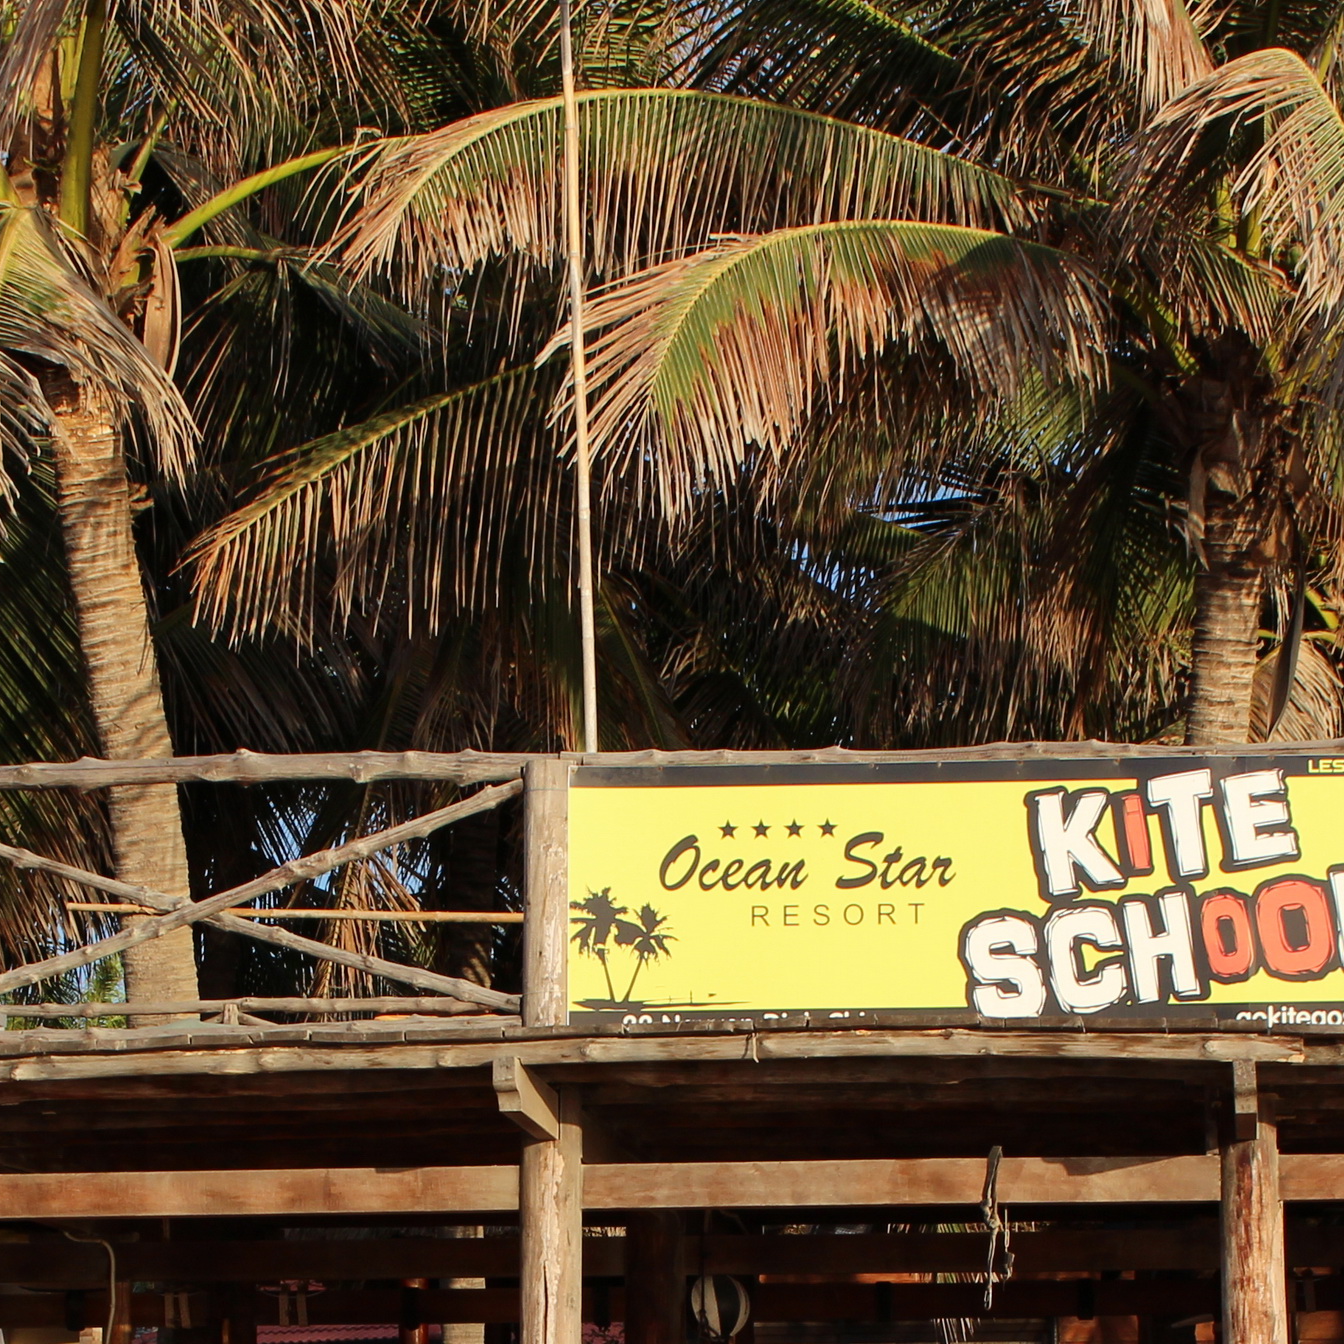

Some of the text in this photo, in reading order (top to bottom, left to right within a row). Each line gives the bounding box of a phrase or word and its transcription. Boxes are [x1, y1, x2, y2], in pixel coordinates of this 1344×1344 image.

[659, 831, 957, 893] Ocean Star
[1030, 768, 1297, 901] KITE
[751, 902, 926, 928] RESORT
